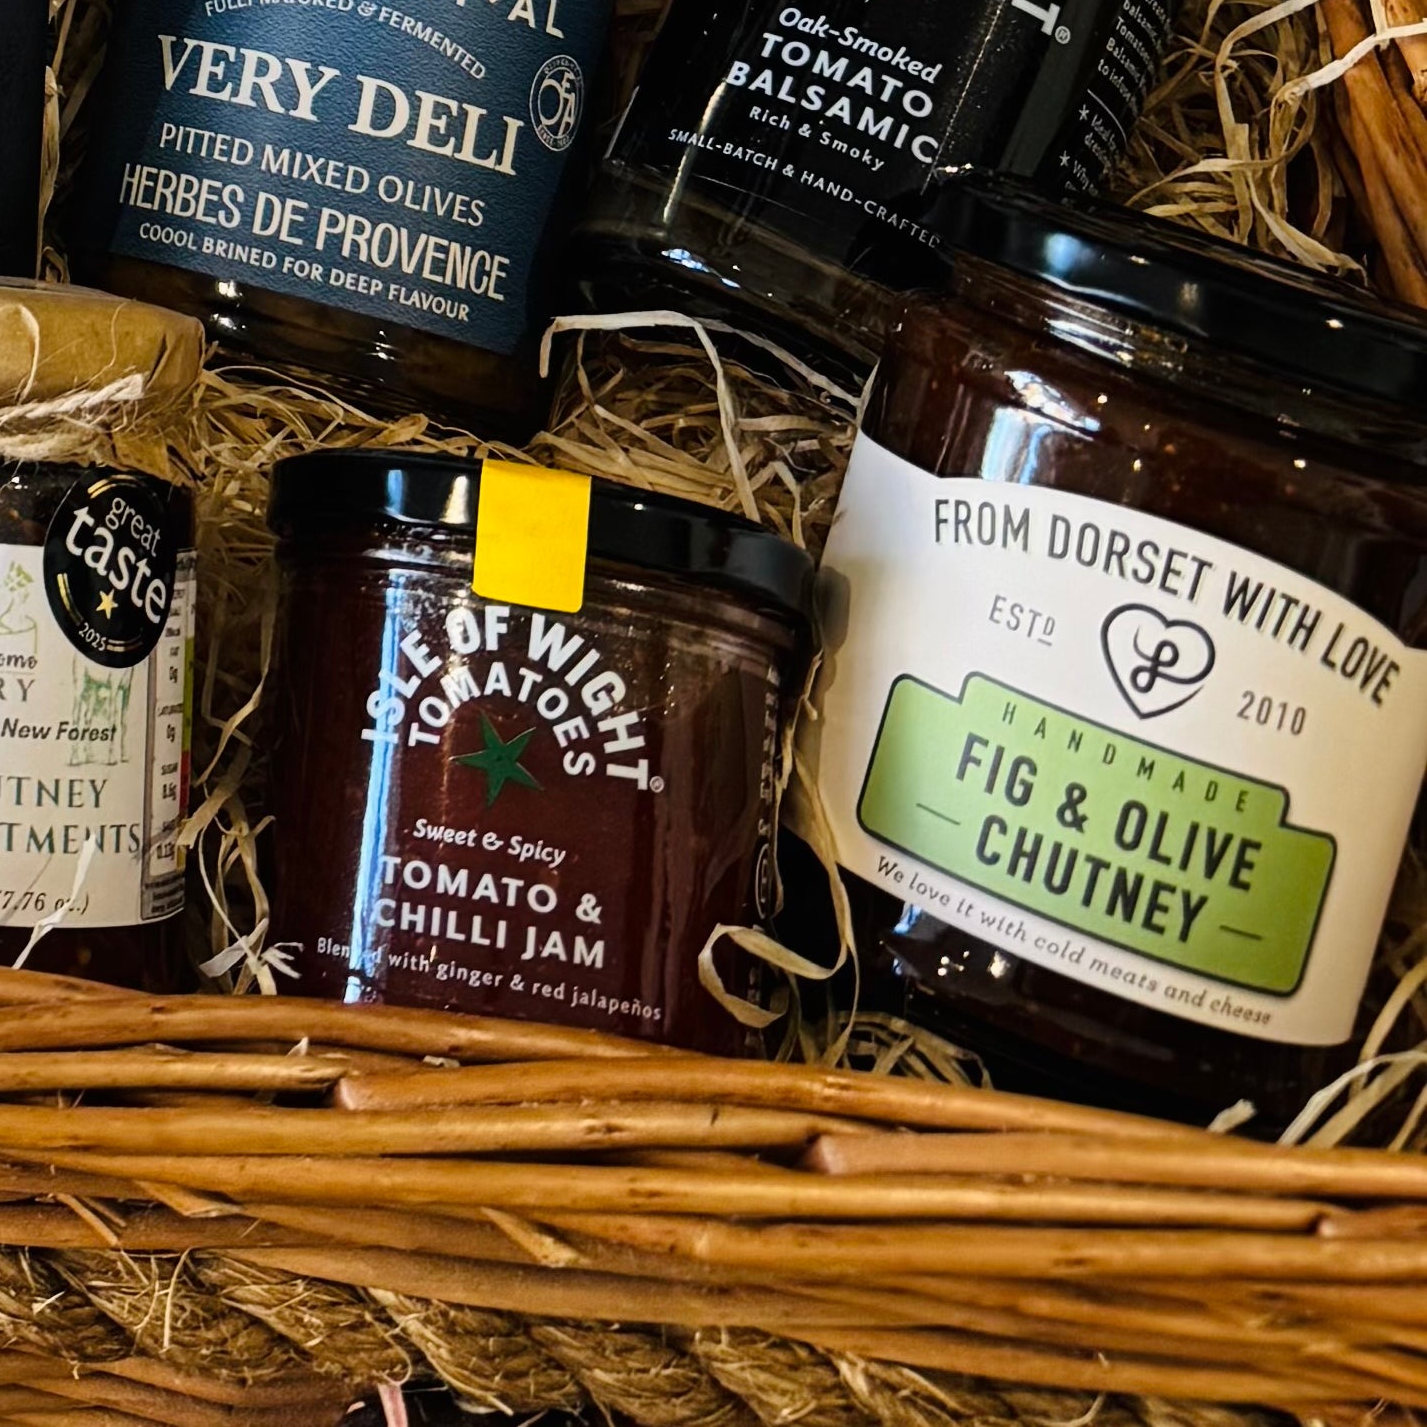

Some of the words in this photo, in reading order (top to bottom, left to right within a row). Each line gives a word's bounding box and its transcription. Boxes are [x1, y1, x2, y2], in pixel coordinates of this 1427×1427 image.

[761, 34, 933, 118] TOMATO
[779, 7, 944, 85] Oak-Smoked
[159, 34, 340, 122] VERY
[349, 74, 525, 176] DELI
[727, 61, 940, 165] BALSAMIC
[160, 123, 254, 165] PITTED
[260, 145, 370, 193] MIXED
[377, 176, 485, 228] OLIVES
[957, 732, 1038, 806] FIG
[1056, 783, 1088, 832] &
[1115, 799, 1262, 892] OLIVE
[975, 815, 1209, 943] CHUTNEY
[374, 899, 507, 949] CHILLI
[521, 926, 606, 968] JAM
